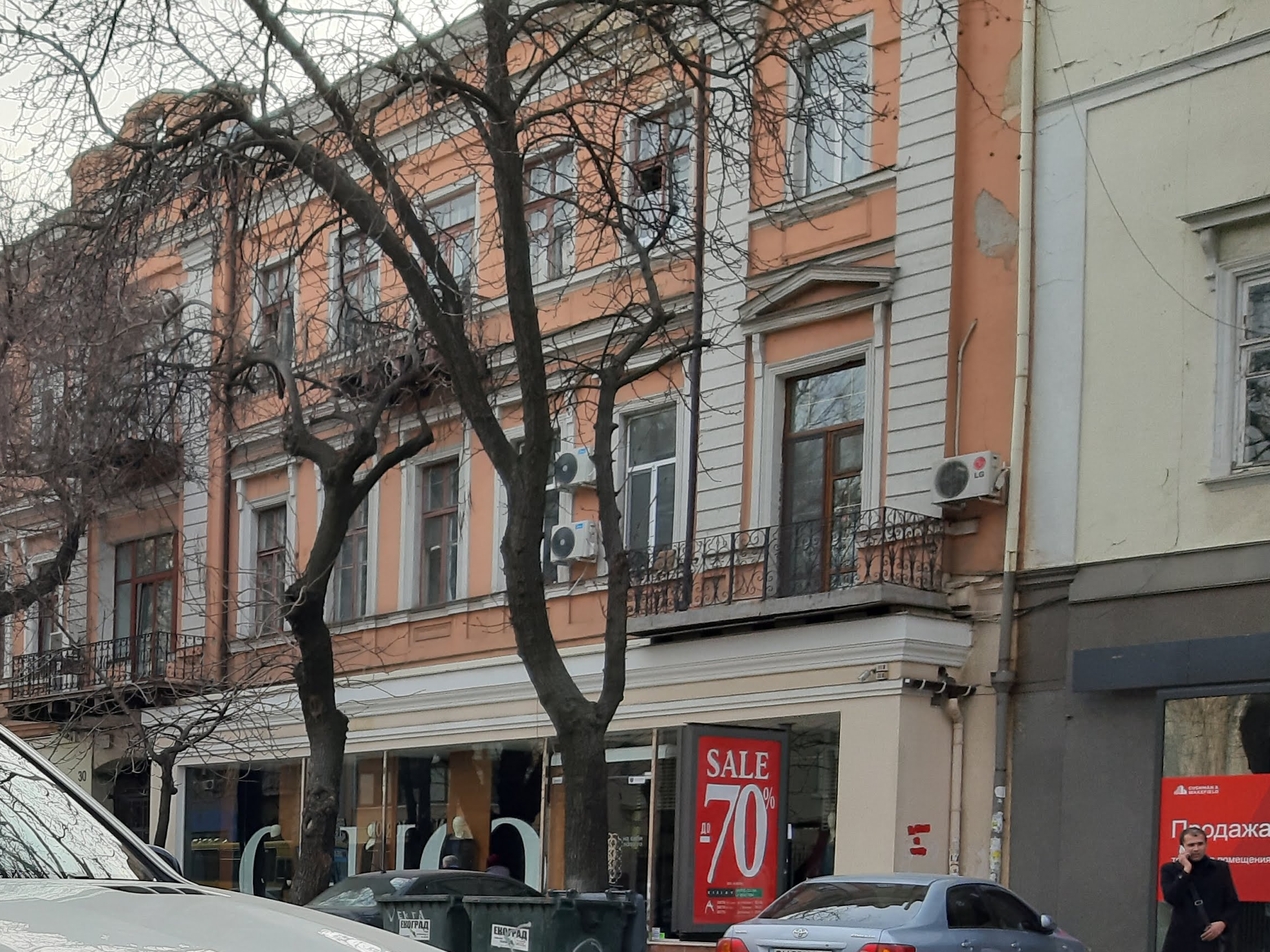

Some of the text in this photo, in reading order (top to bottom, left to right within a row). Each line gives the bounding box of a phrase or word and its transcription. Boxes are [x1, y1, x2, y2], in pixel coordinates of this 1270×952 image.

[974, 471, 985, 479] LG
[706, 748, 770, 780] SALE
[77, 770, 87, 782] 30
[1171, 820, 1270, 841] Подажа
[400, 920, 429, 930] ЕКОГРАД
